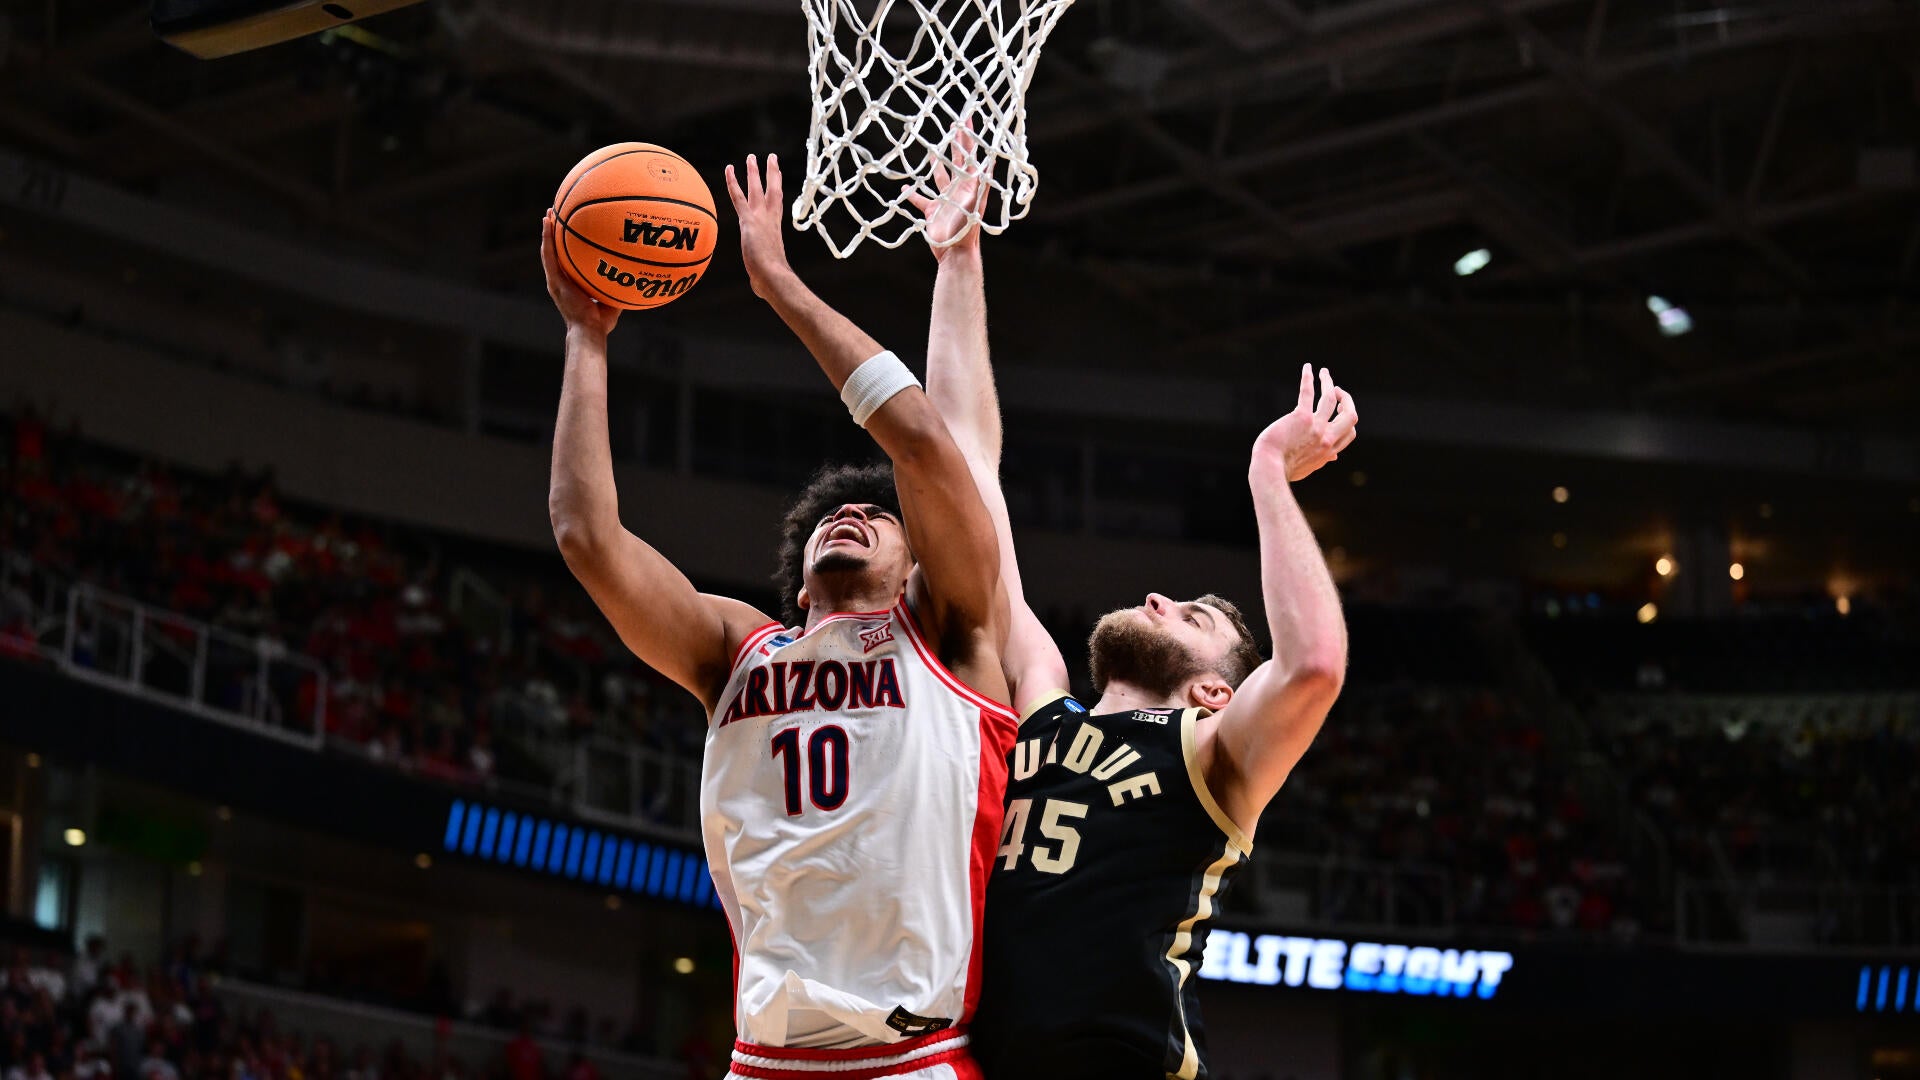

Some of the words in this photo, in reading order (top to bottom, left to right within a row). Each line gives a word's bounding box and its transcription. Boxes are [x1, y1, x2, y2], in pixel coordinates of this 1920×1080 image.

[623, 218, 700, 251] NCAA
[596, 258, 698, 299] Wilson
[719, 658, 906, 728] ARIZONA
[771, 725, 850, 816] 10
[997, 798, 1089, 874] 45
[1197, 929, 1347, 990] ELITE
[1344, 942, 1514, 999] EIGHT
